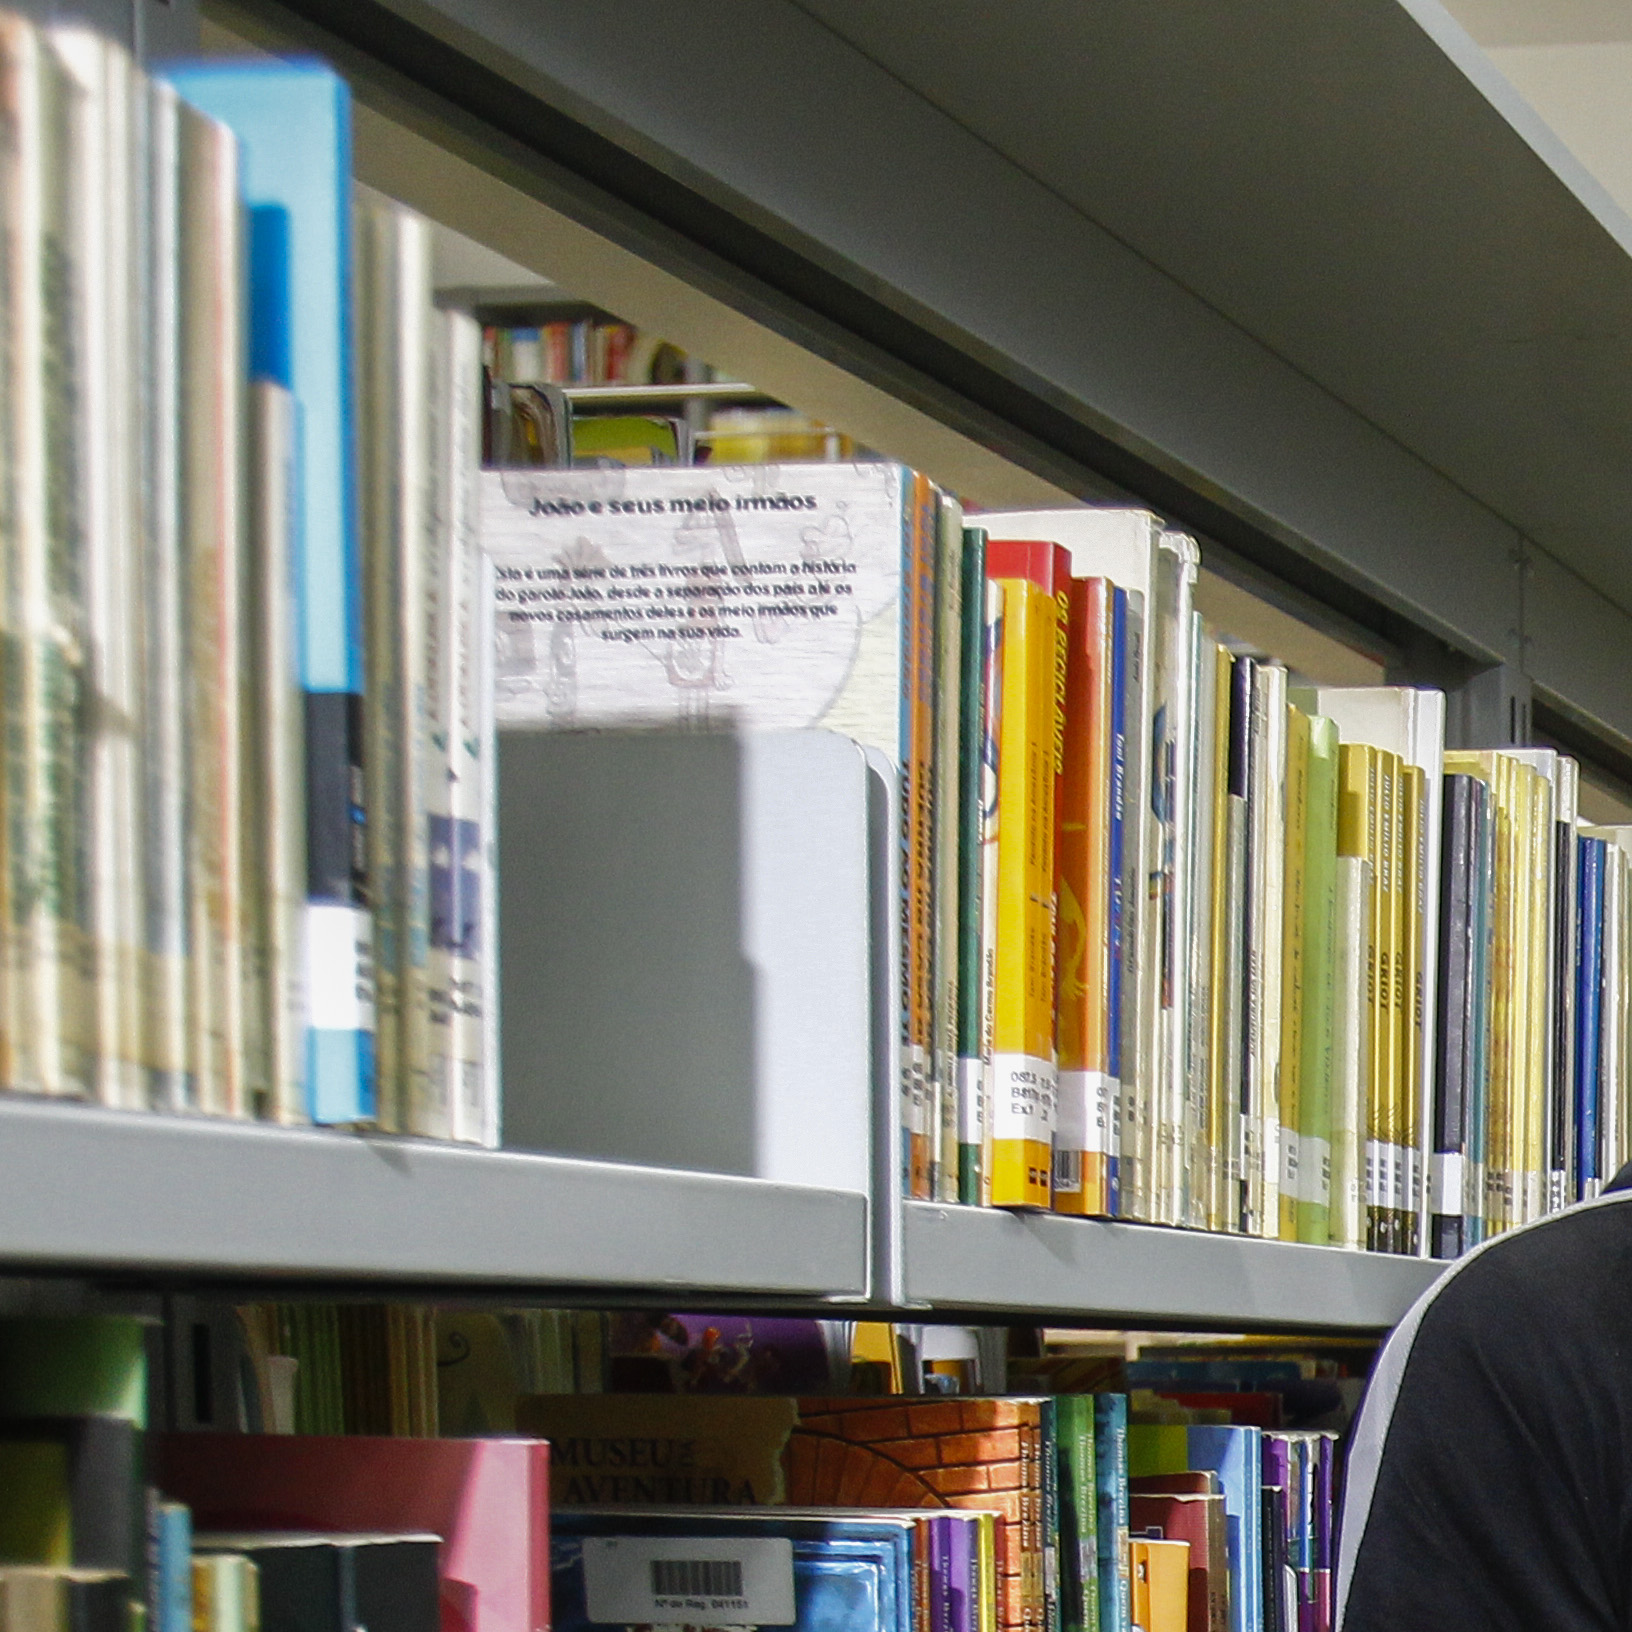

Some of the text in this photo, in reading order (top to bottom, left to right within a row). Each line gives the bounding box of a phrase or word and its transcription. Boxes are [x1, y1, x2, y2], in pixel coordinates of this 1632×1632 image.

[529, 494, 584, 517] João
[589, 499, 604, 515] e
[609, 498, 666, 515] seus
[670, 496, 730, 514] meio
[701, 565, 728, 582] que
[607, 584, 651, 600] desde
[551, 1437, 674, 1468] MUSEU
[565, 1476, 758, 1505] AVENTURA
[1117, 1477, 1126, 1524] Brezina
